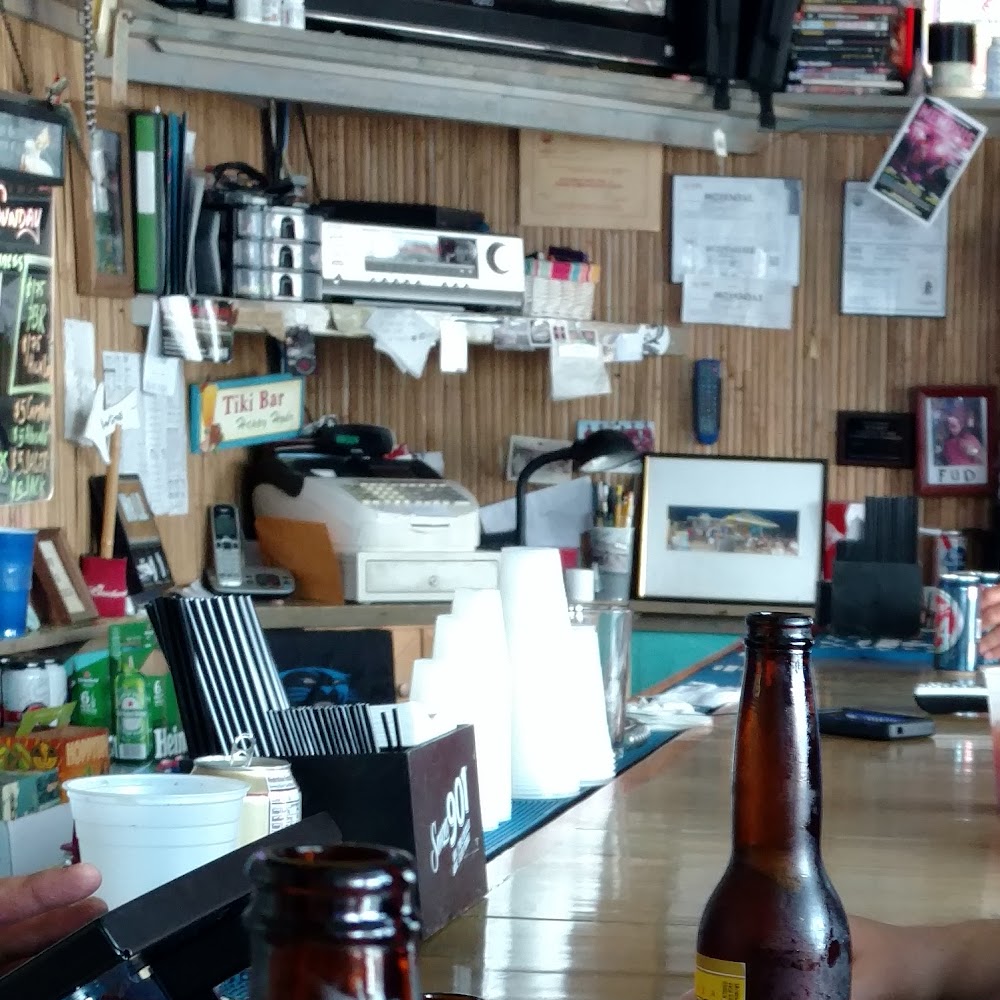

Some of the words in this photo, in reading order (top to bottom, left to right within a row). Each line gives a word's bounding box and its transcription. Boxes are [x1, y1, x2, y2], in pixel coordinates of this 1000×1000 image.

[222, 393, 254, 416] Tiki
[258, 389, 285, 410] Bar
[938, 468, 977, 483] FUD
[445, 764, 470, 849] 901
